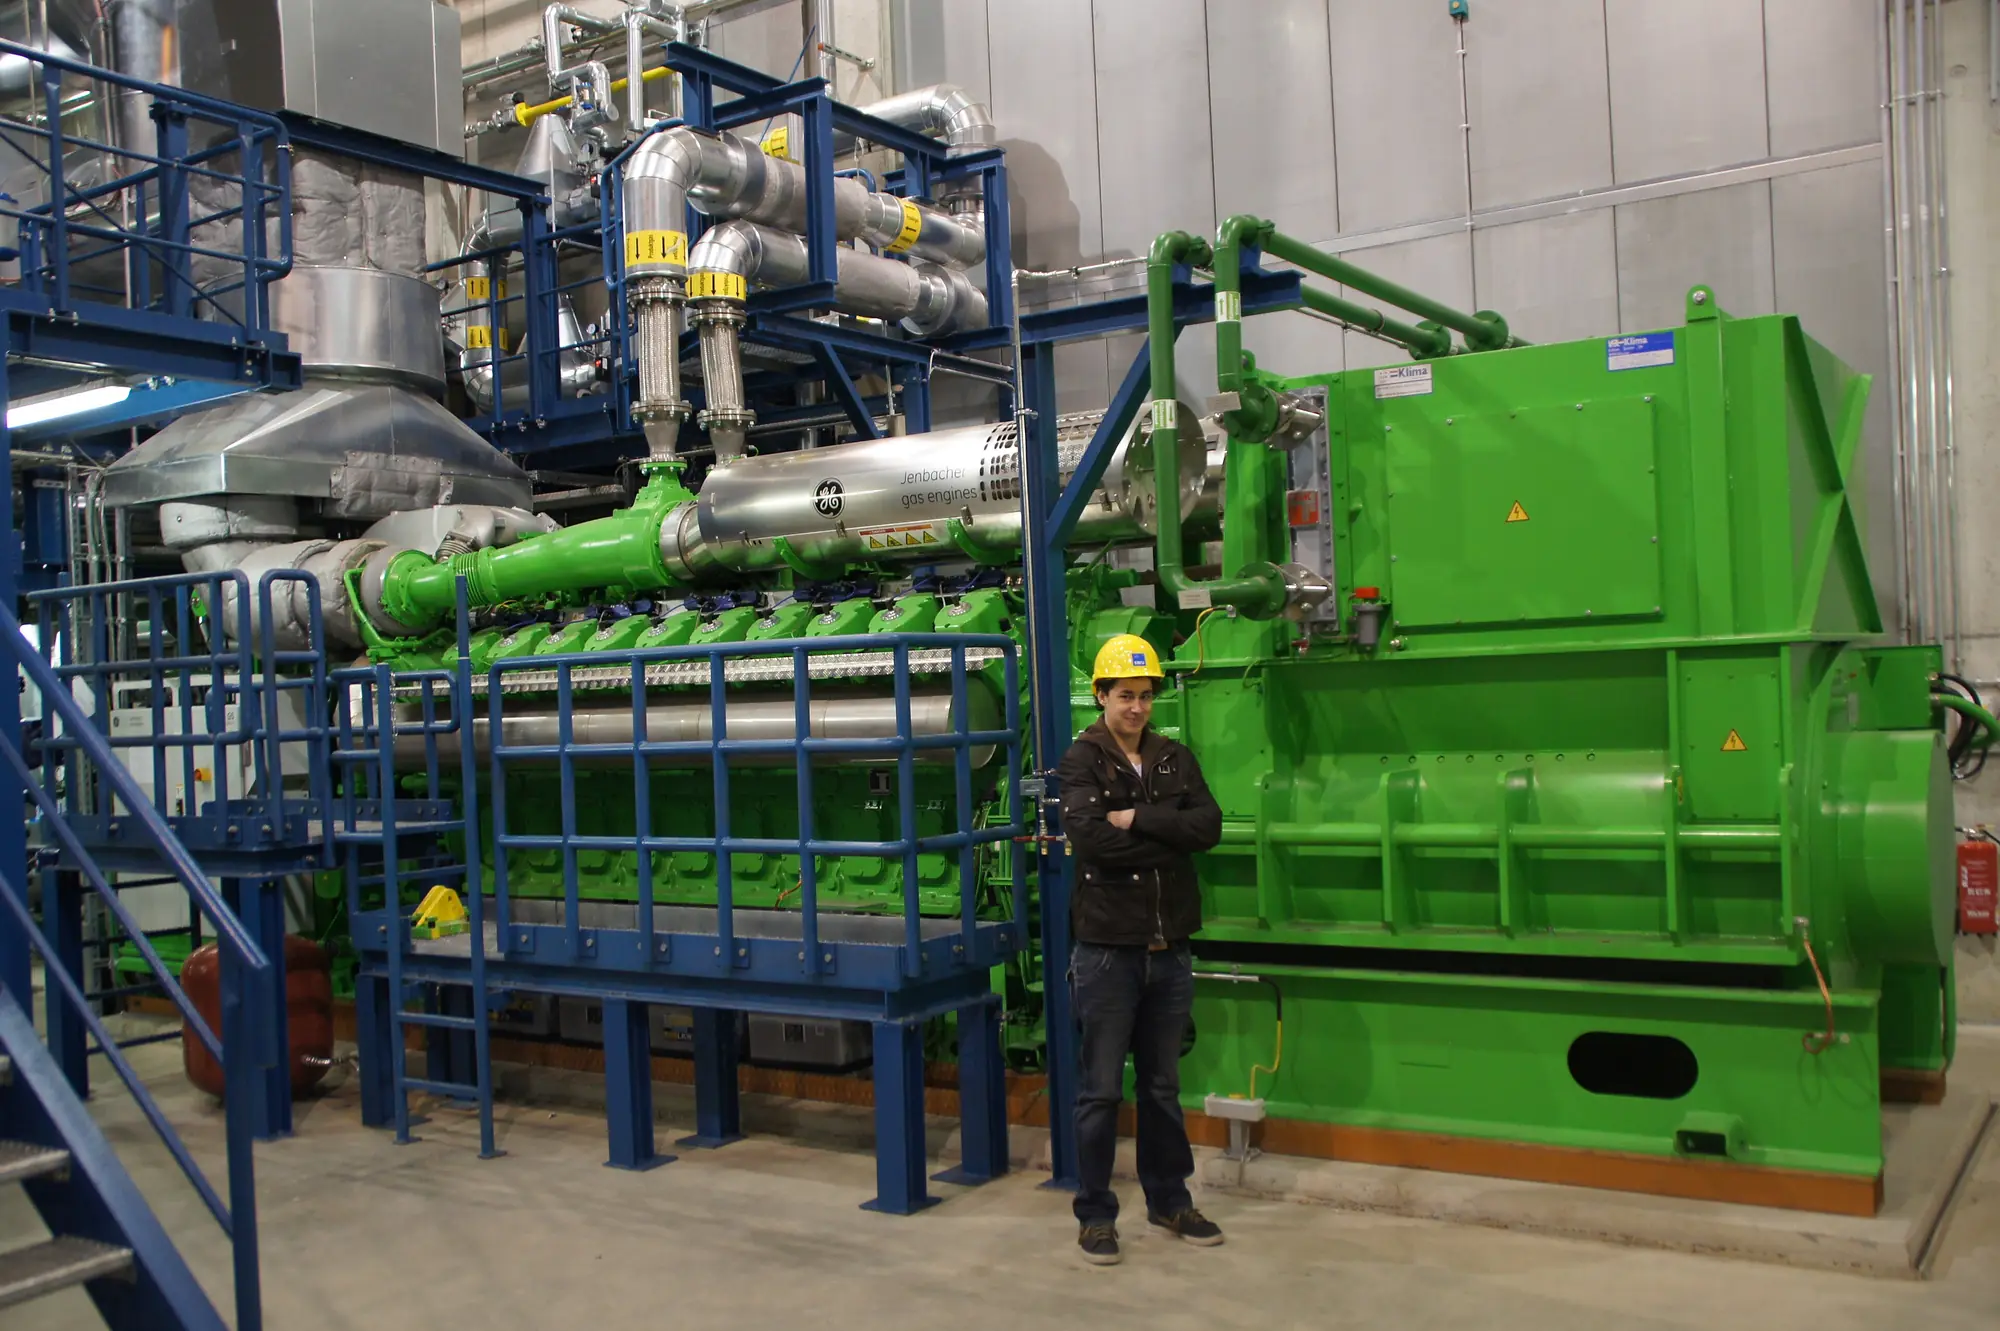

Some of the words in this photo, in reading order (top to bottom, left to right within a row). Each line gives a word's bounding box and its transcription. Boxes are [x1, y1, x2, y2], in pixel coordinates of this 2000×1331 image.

[901, 467, 965, 485] Jenbacher
[901, 492, 925, 509] gas
[927, 486, 978, 506] engines
